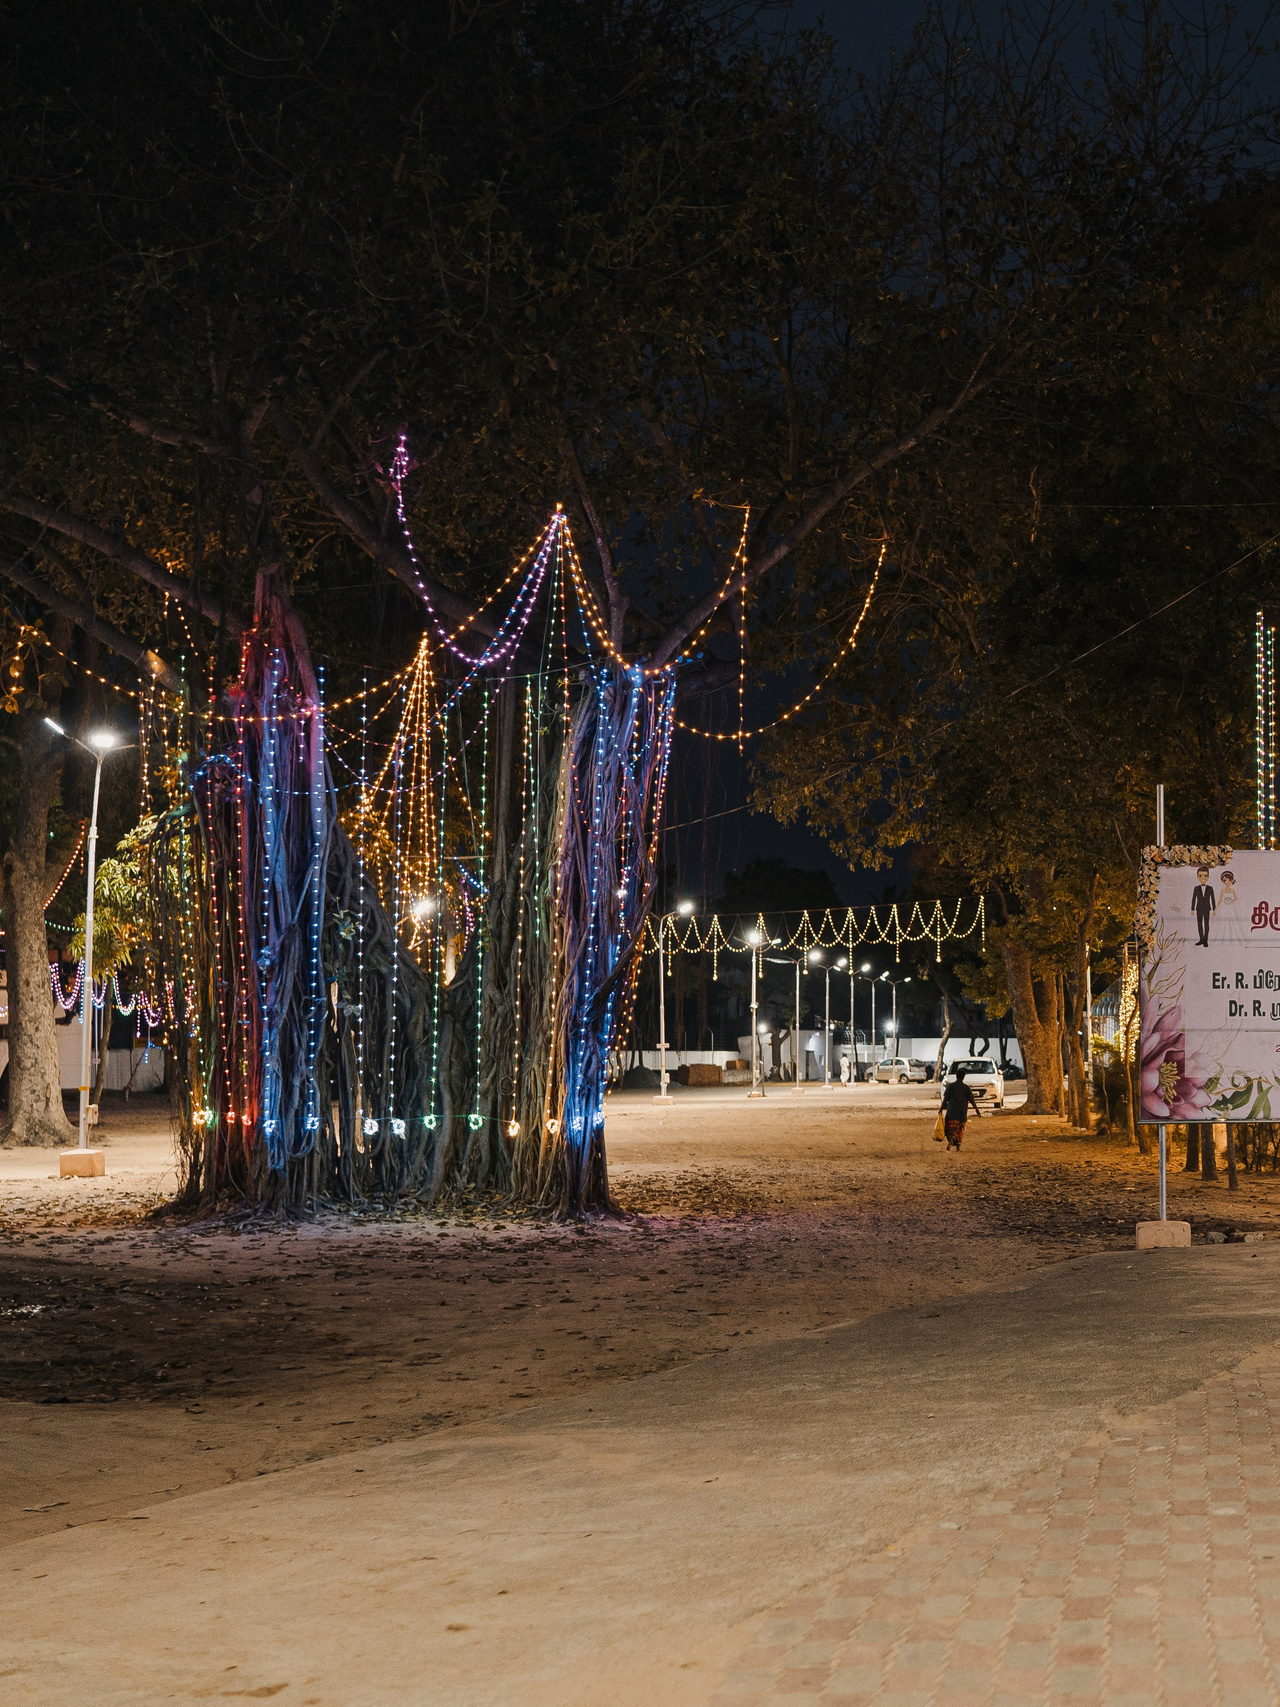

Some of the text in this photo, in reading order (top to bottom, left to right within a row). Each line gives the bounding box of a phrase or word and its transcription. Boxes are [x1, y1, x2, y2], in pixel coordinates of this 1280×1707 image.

[1212, 972, 1231, 989] Er.
[1235, 972, 1249, 989] R.
[1228, 999, 1248, 1017] Dr.
[1252, 999, 1266, 1017] R.
